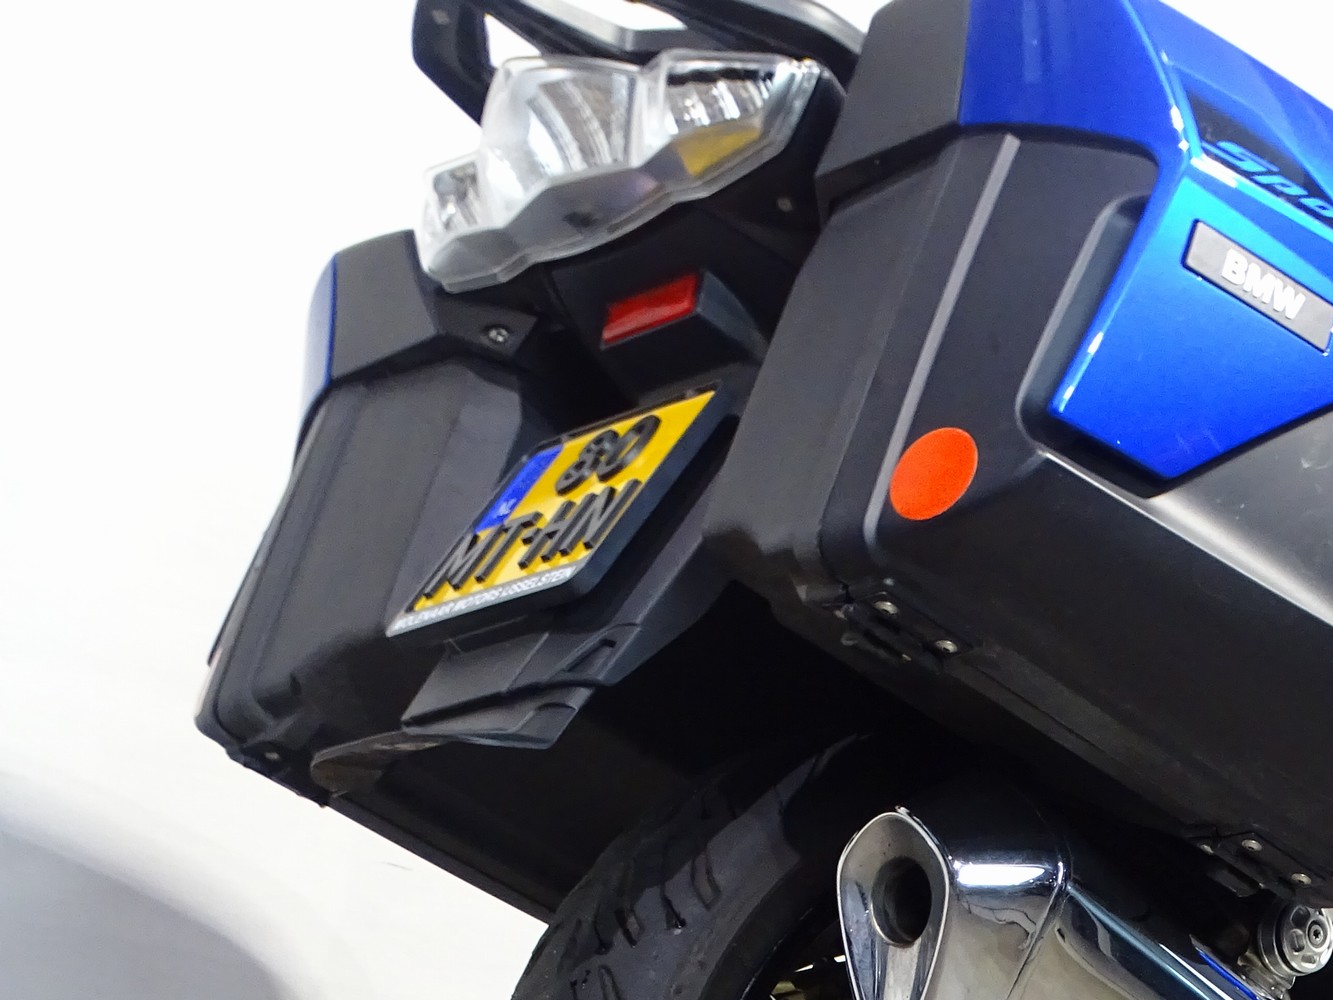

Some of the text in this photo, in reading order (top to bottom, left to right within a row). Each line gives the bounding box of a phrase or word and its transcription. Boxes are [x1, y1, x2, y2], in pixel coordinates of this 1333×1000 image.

[1220, 248, 1306, 320] BMW
[556, 414, 661, 496] 80
[420, 477, 643, 600] MT-HN
